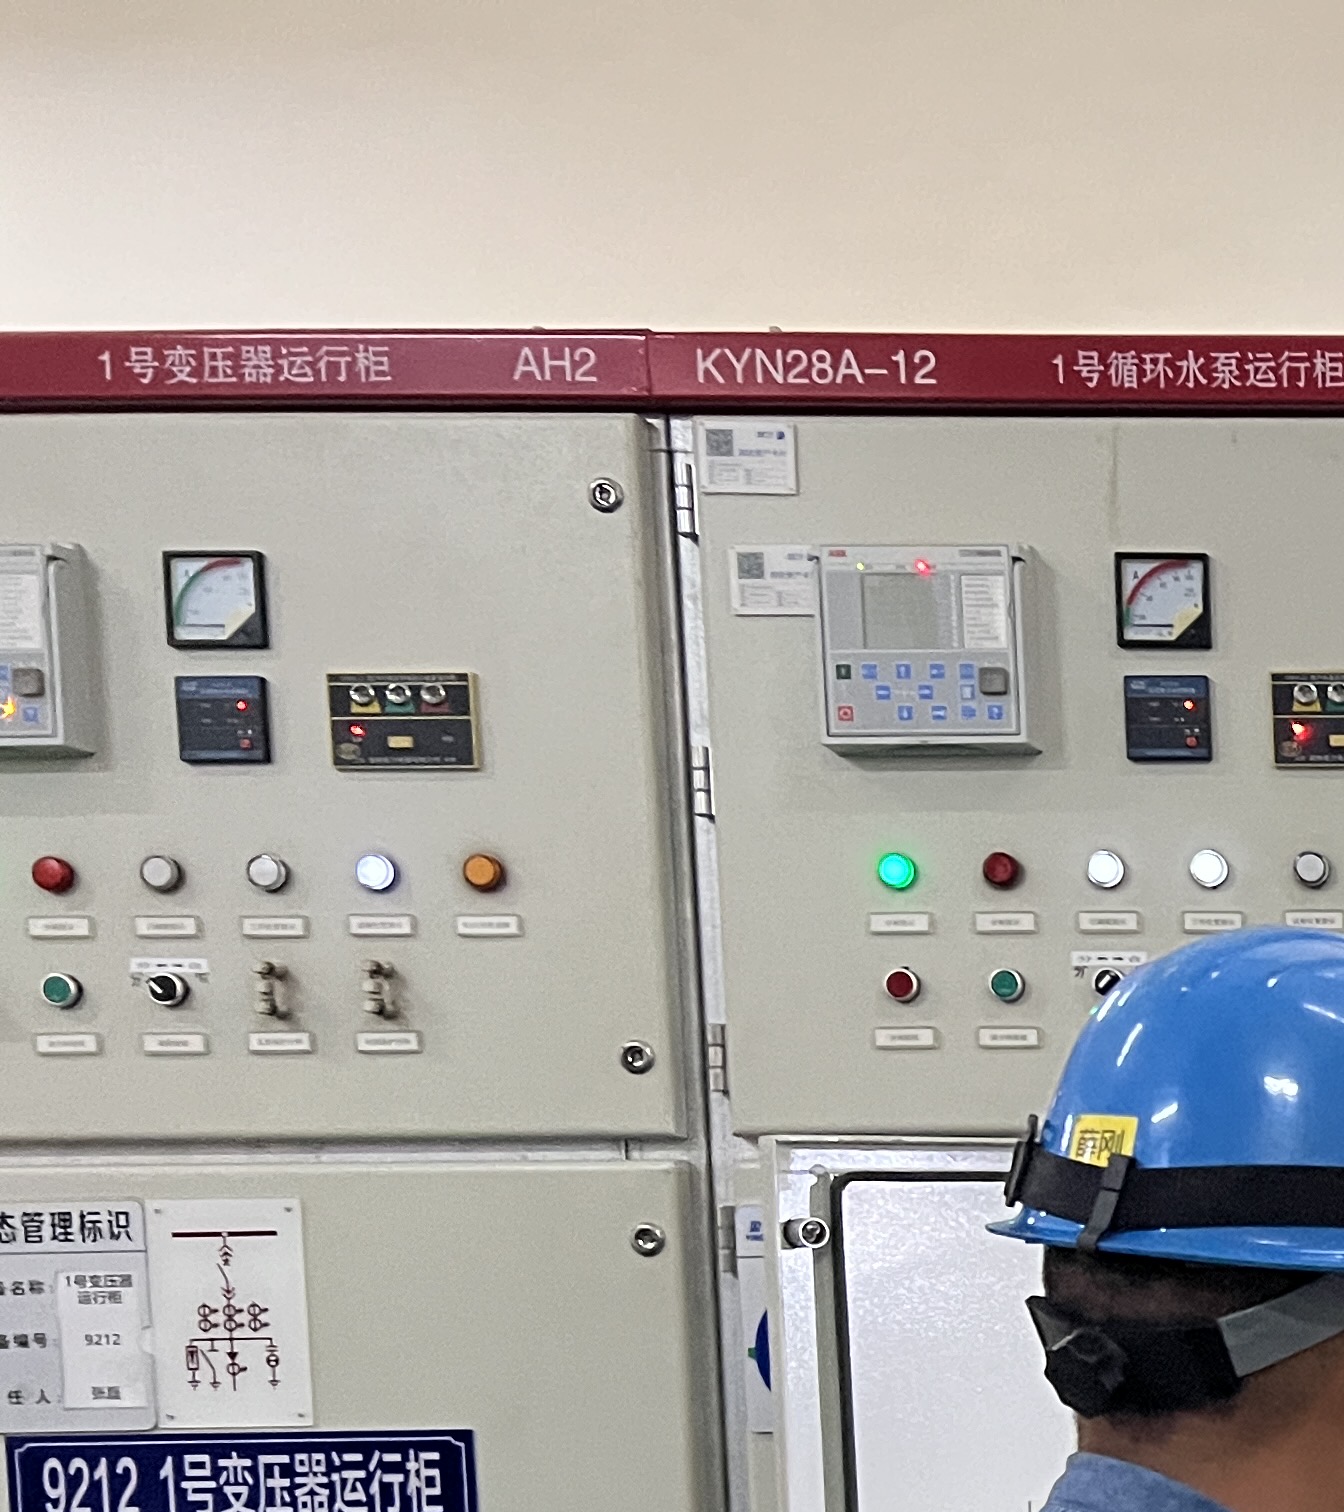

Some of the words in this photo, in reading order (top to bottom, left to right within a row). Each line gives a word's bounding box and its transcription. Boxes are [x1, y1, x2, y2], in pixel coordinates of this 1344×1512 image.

[98, 344, 392, 386] 1号变压器运行柜
[513, 347, 598, 383] AH2
[696, 348, 937, 385] KYN28A-12
[1052, 350, 1344, 389] 1号循环水泵运行柜
[84, 1333, 120, 1346] 9212
